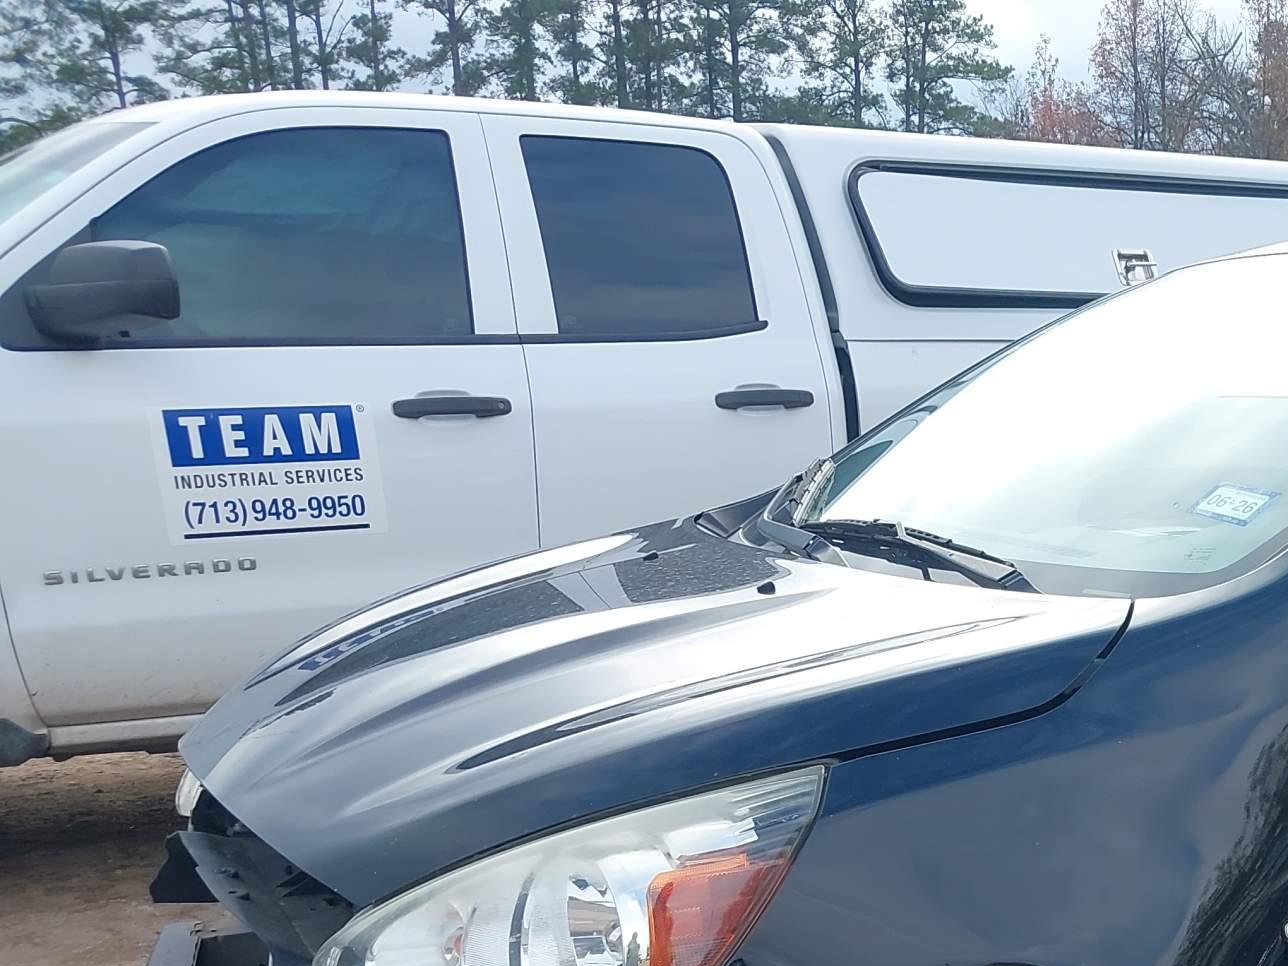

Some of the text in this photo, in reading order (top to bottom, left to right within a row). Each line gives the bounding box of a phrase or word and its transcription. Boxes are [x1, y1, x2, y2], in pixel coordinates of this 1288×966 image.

[177, 413, 342, 459] TEAM
[174, 467, 364, 490] INDUSTRIAL SERVICES
[42, 556, 257, 586] SILVERADO
